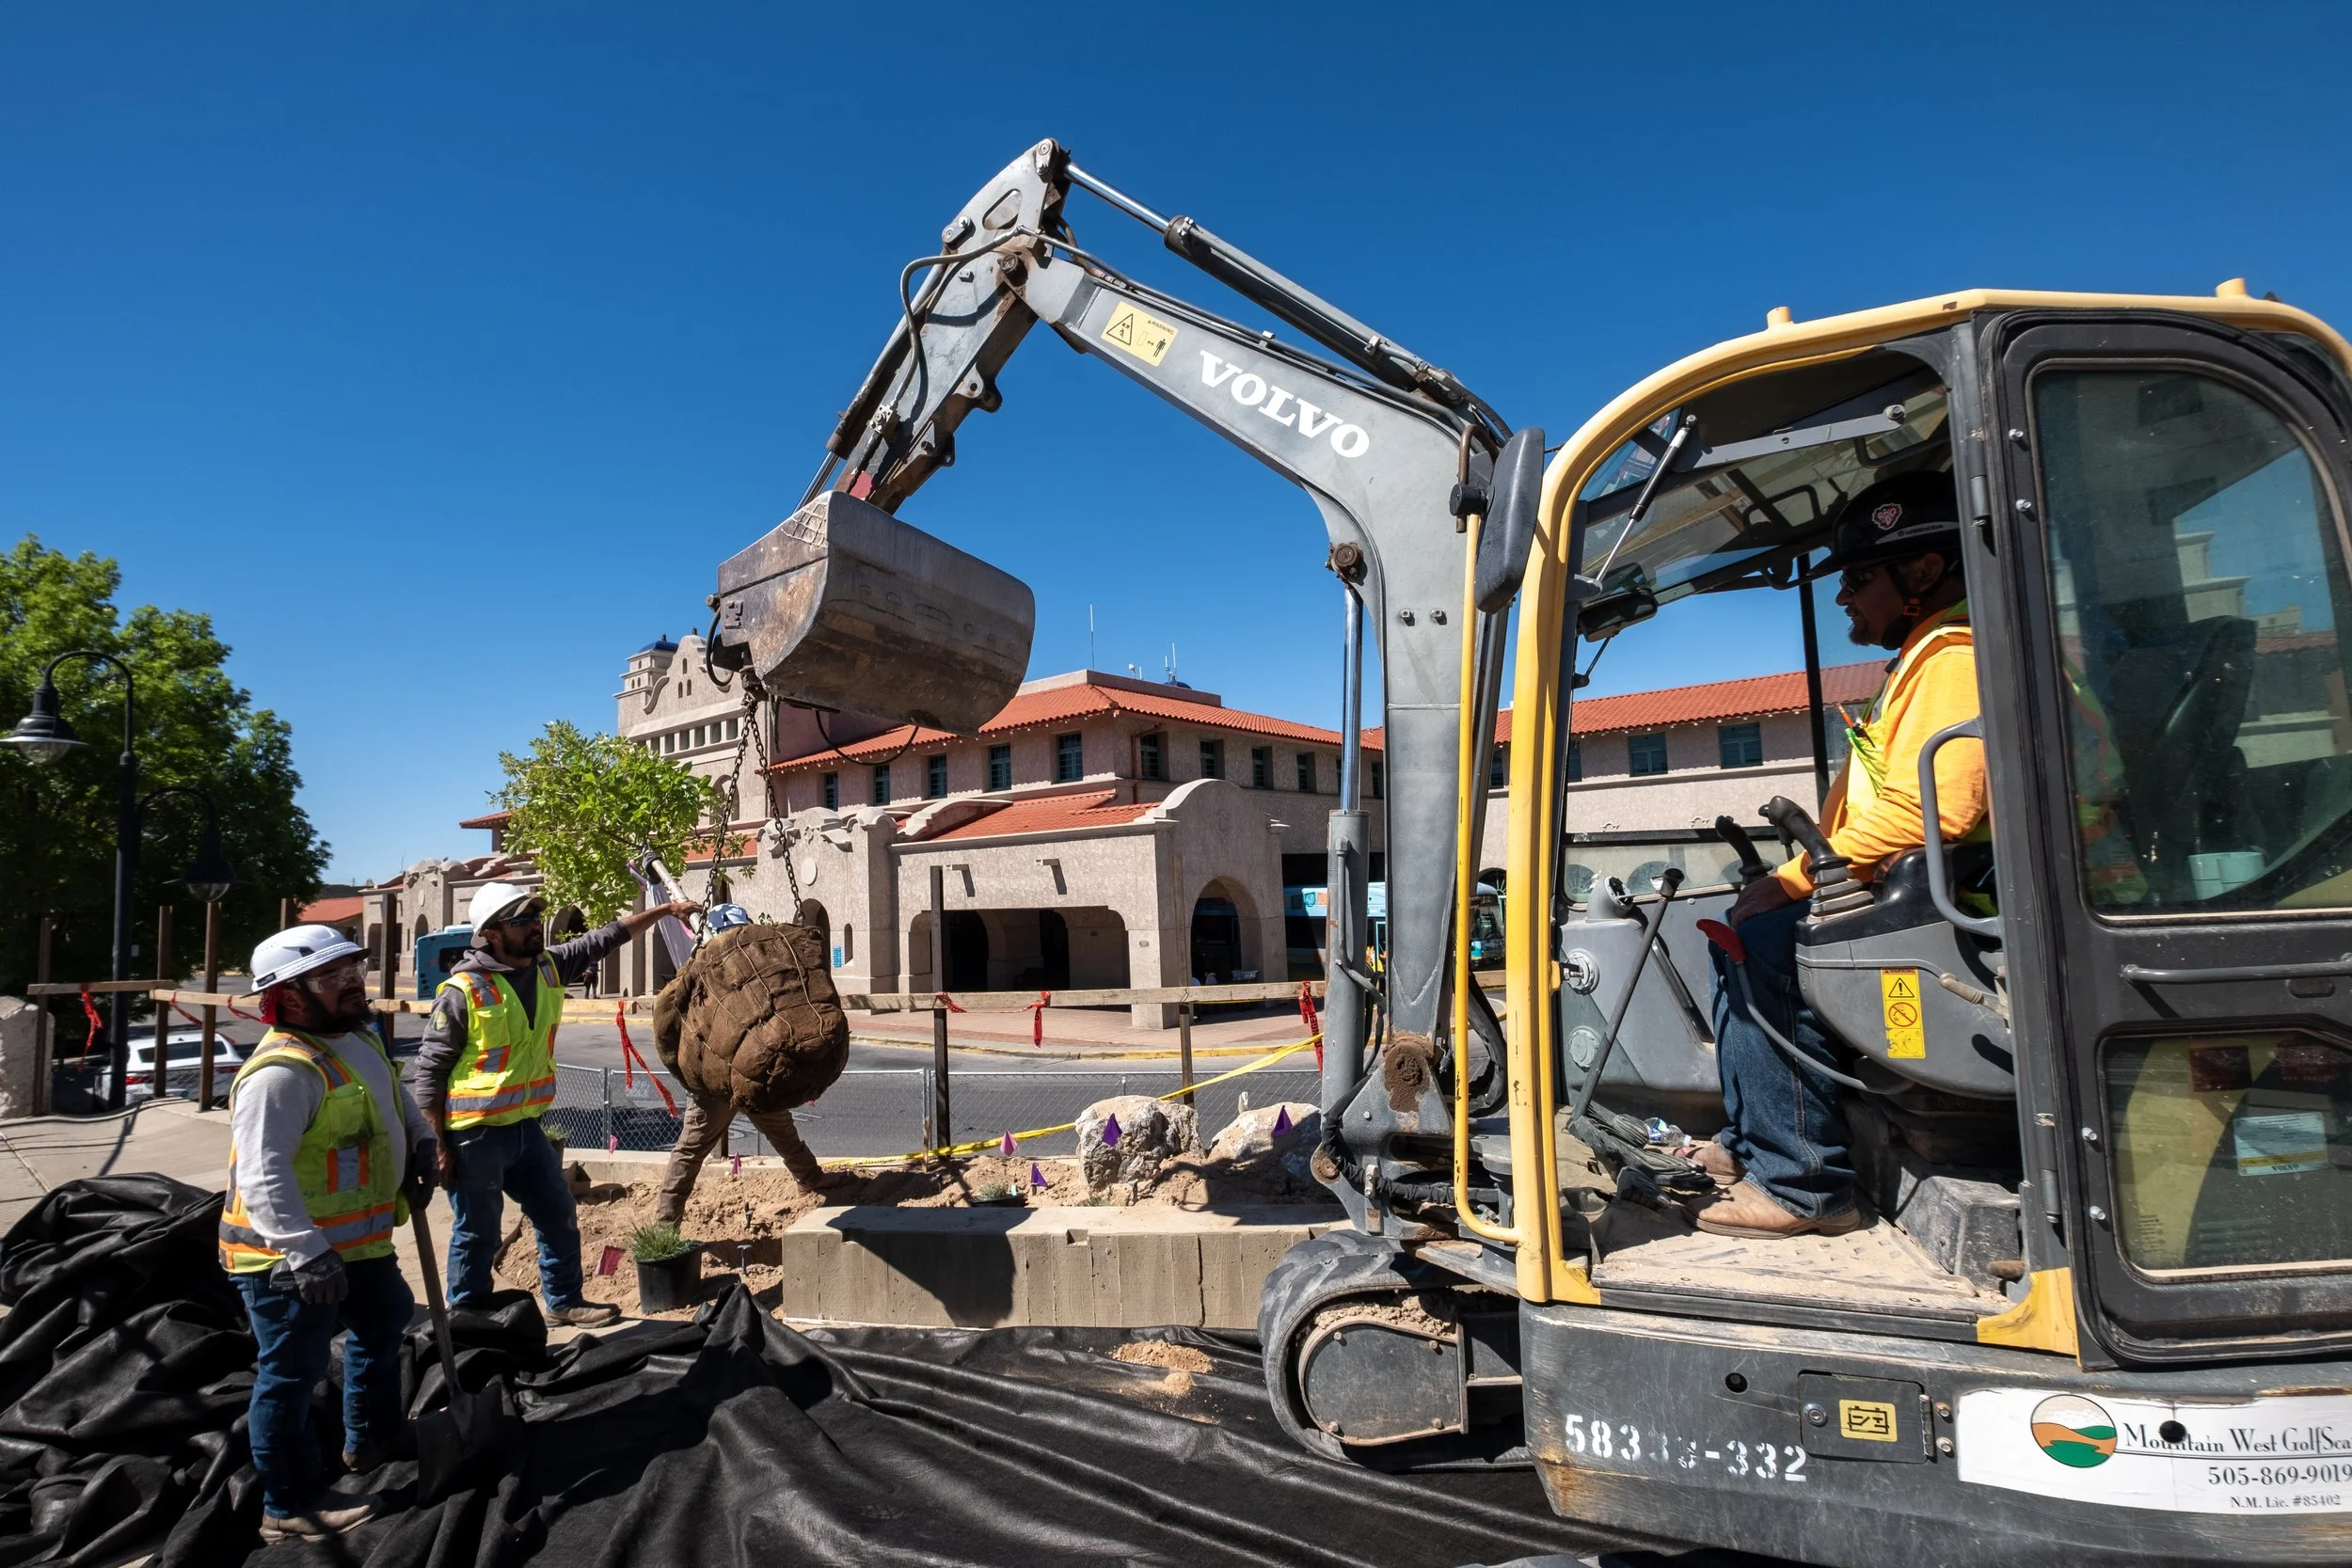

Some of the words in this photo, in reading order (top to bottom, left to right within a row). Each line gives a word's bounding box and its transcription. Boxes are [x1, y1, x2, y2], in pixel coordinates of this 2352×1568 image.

[1151, 321, 1175, 336] WARNING
[1199, 350, 1370, 458] VOLVO
[1309, 1011, 1324, 1048] DNGER
[2228, 1427, 2278, 1452] West
[2281, 1425, 2352, 1454] GolfSca
[2208, 1463, 2352, 1486] 505-869-9019
[2230, 1496, 2263, 1509] N.M.
[2265, 1497, 2289, 1509] Lic.
